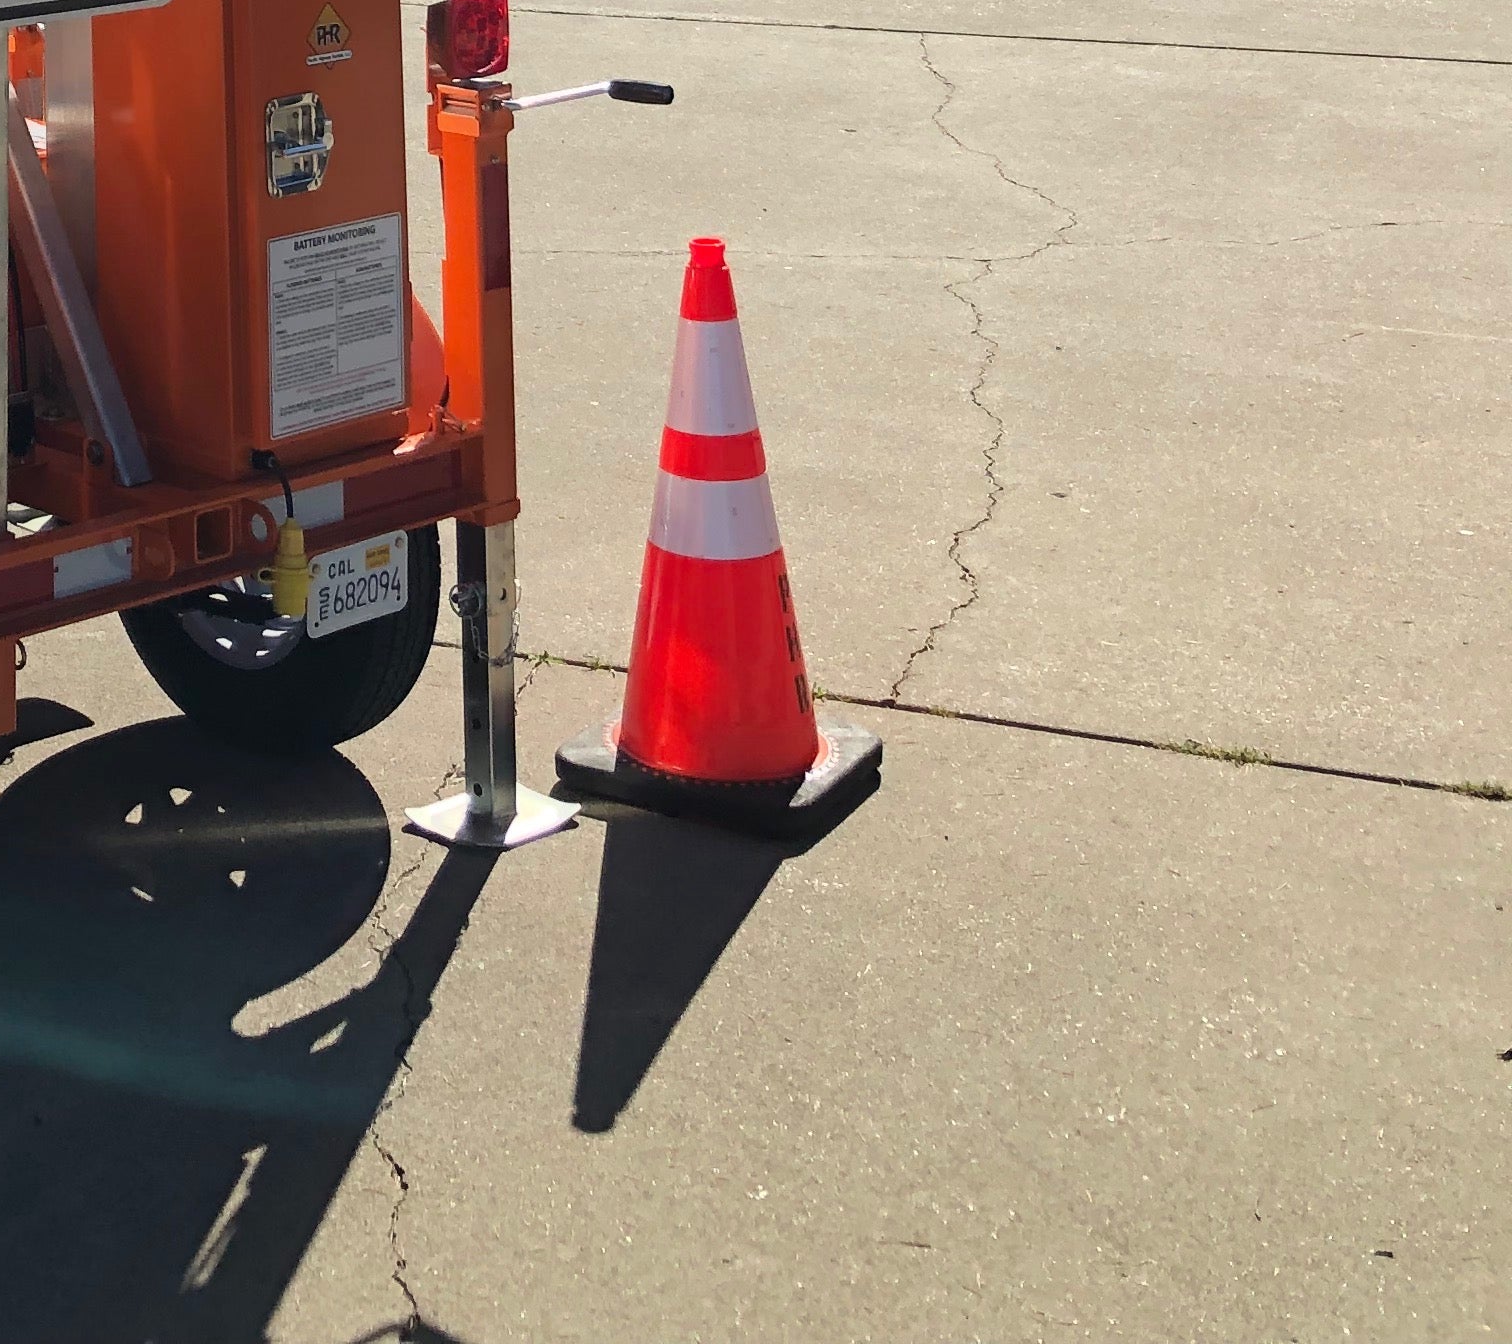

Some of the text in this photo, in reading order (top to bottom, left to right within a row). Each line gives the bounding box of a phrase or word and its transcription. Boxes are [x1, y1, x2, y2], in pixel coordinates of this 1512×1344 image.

[316, 23, 341, 46] PHR
[293, 224, 376, 251] BATTERY MONITORING
[328, 559, 355, 580] CAL
[333, 566, 401, 615] 682094
